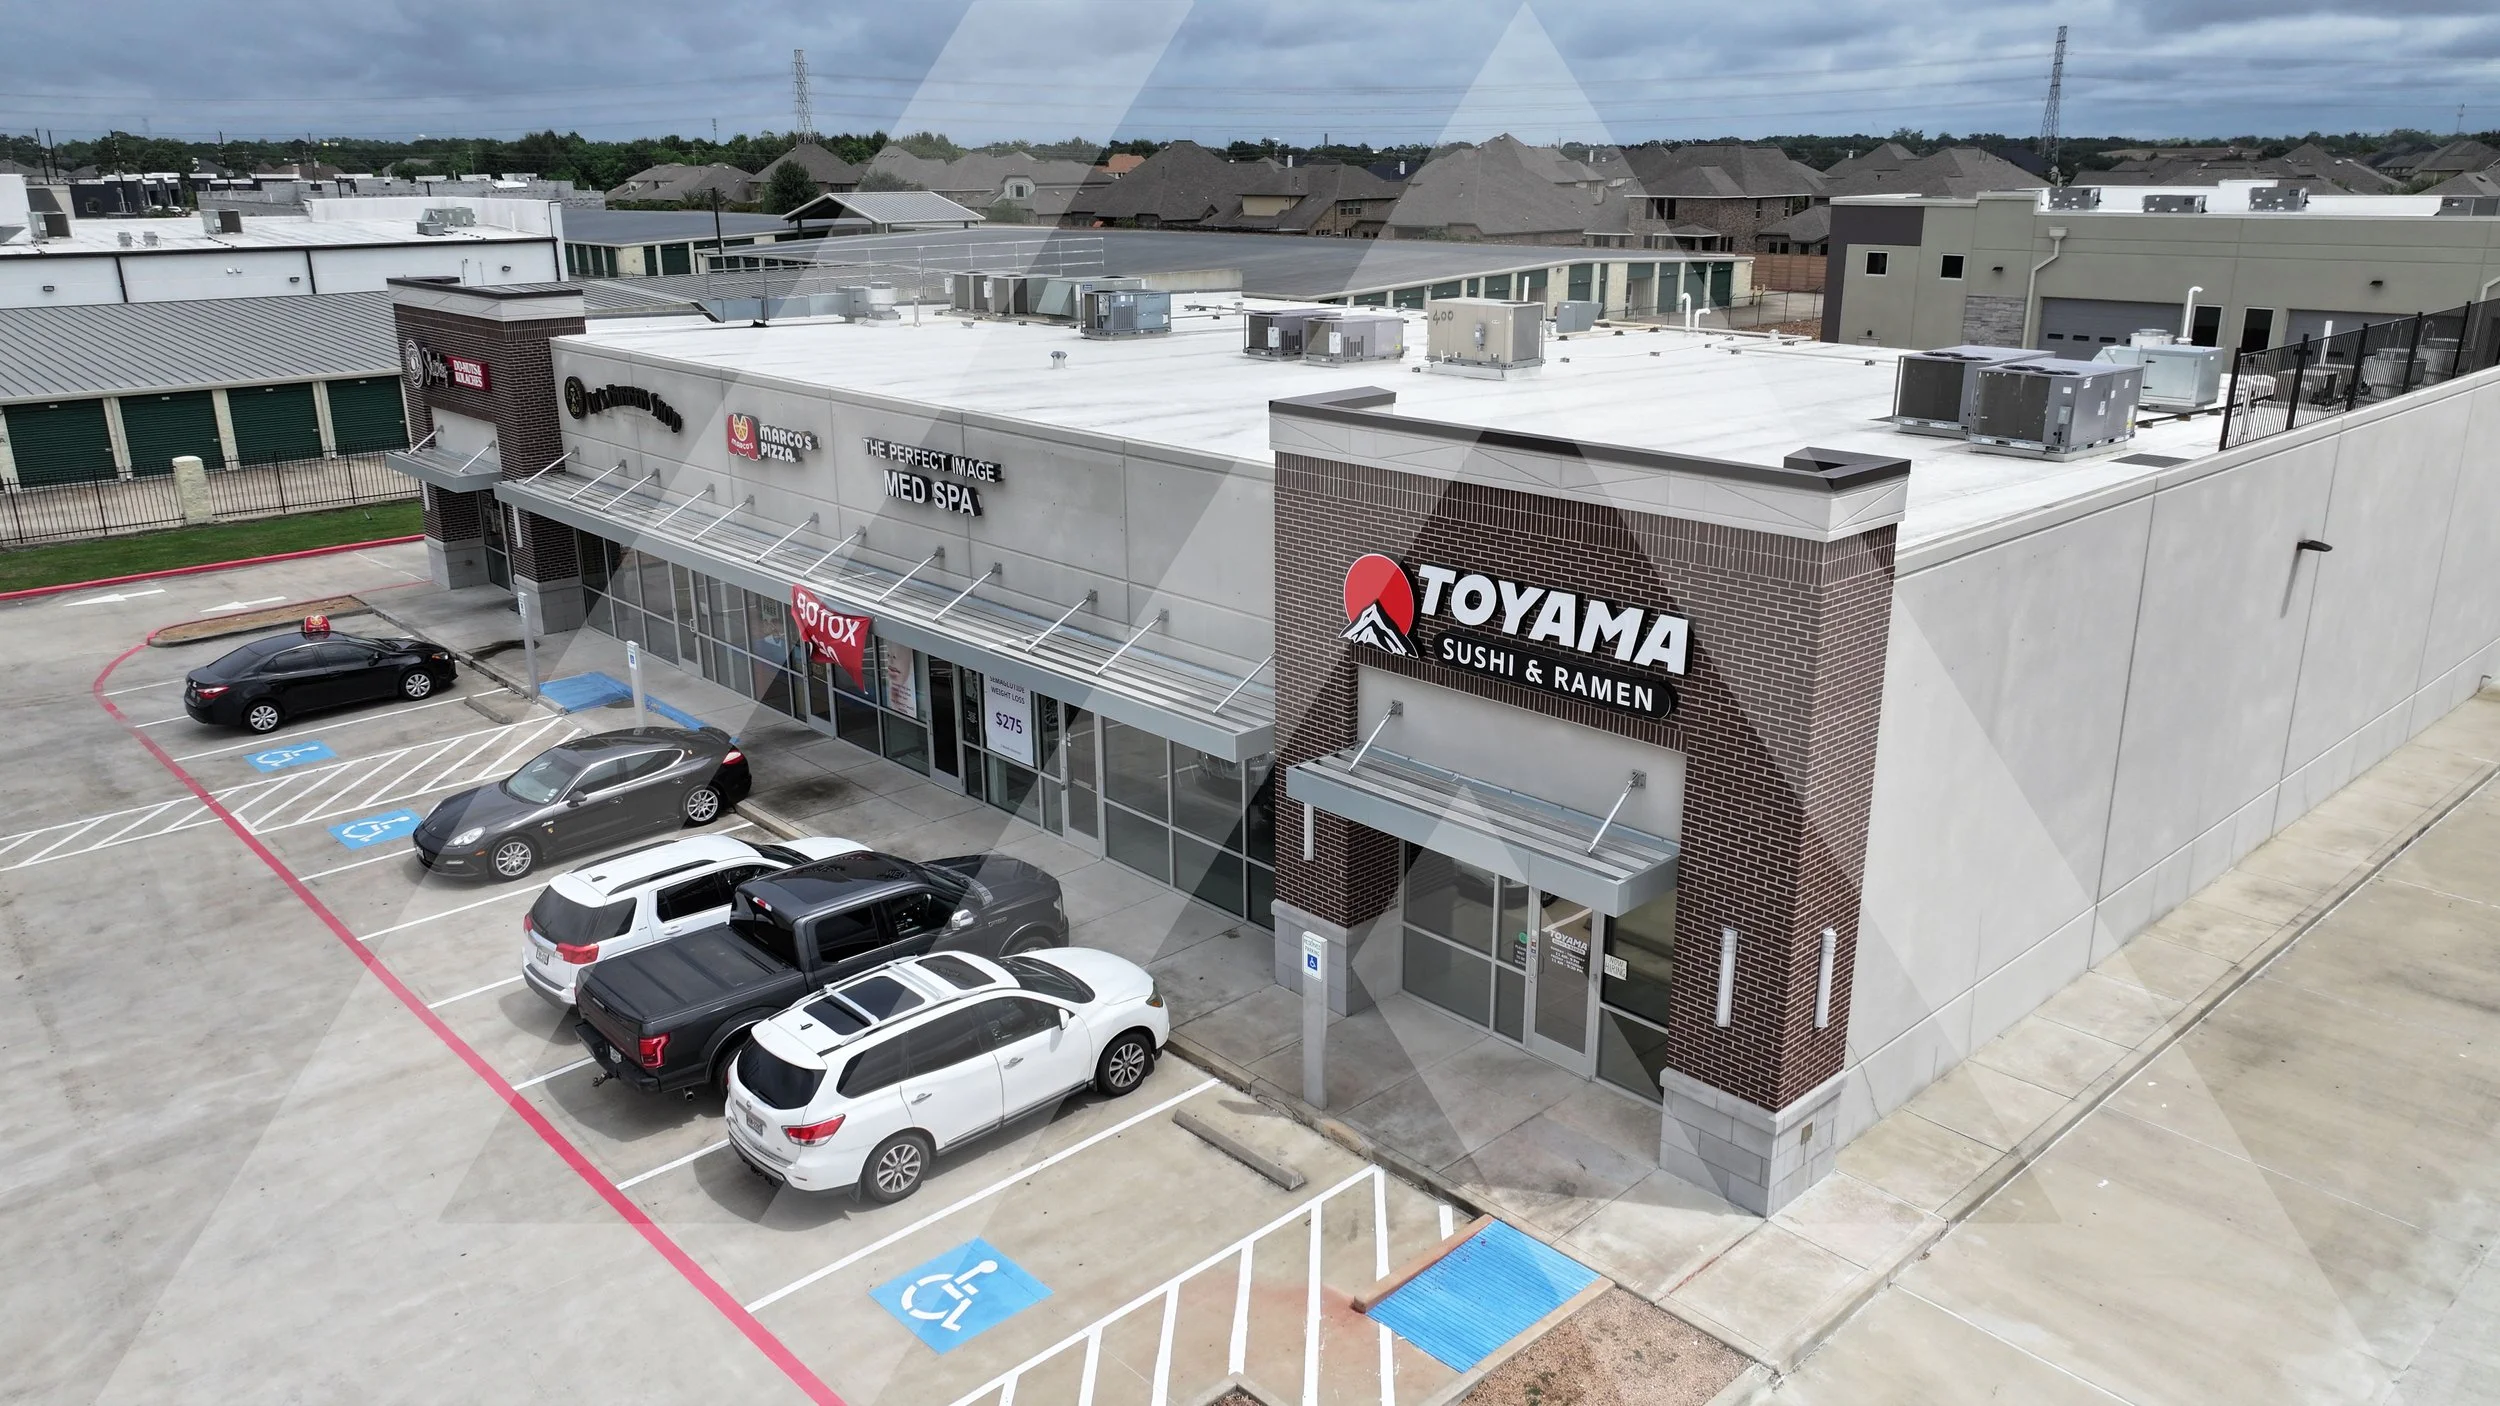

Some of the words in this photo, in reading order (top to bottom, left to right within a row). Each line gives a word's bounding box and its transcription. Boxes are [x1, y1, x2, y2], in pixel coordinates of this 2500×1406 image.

[1432, 310, 1454, 327] 400
[454, 371, 483, 388] KOLACHES
[731, 438, 754, 449] MARCO'S
[760, 426, 812, 451] MARCO'S
[761, 442, 793, 462] PIZZA
[862, 437, 886, 459] THE
[890, 442, 947, 472] PERFECT
[951, 457, 996, 483] IMAGE
[883, 469, 926, 505] MED
[933, 481, 975, 517] SPA
[797, 592, 860, 647] BOTOX
[1418, 563, 1690, 676] TOYAMA
[1442, 638, 1514, 677] SUSHI
[1525, 659, 1543, 685] &
[1554, 666, 1653, 712] RAMEN
[990, 686, 1011, 700] WEIGHT
[1011, 694, 1025, 705] LOSS
[995, 711, 1023, 735] $275
[1550, 929, 1588, 951] TOYAMA
[1604, 963, 1626, 978] HIRING
[1609, 956, 1625, 968] NOW
